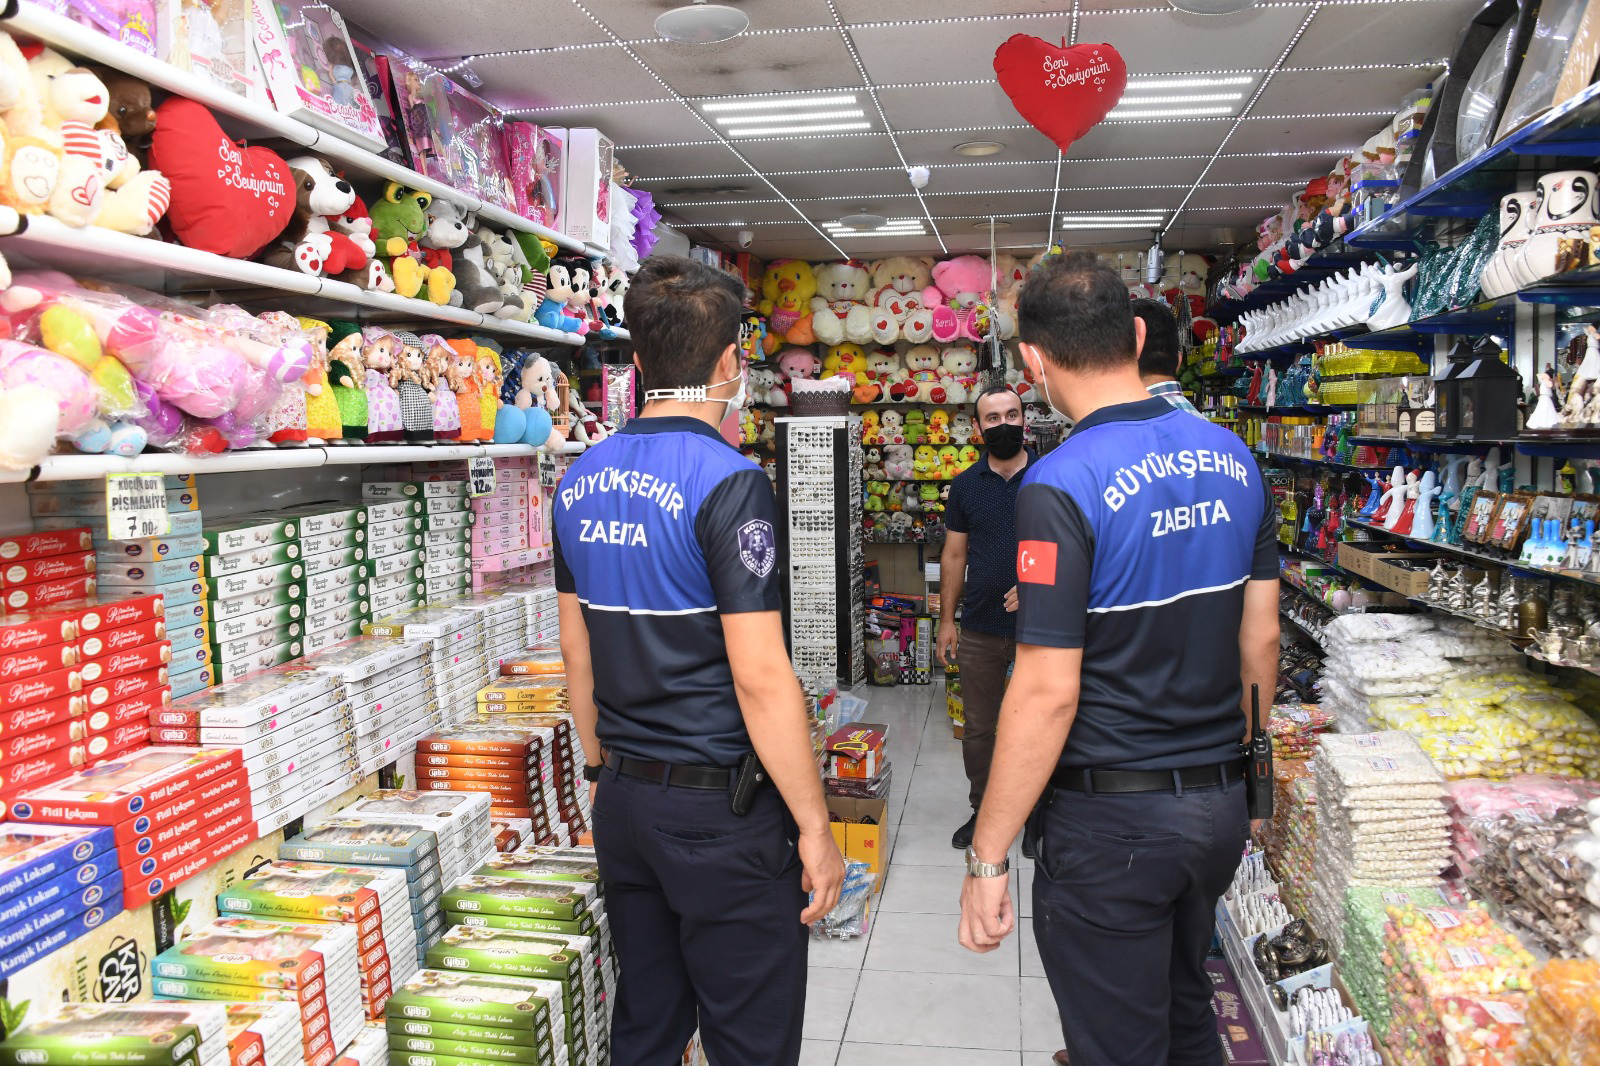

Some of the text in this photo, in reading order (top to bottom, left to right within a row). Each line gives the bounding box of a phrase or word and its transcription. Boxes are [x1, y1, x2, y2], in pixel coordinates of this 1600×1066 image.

[250, 0, 275, 45] Beau
[1043, 55, 1069, 72] Seni
[1057, 62, 1111, 86] Seviyorum
[219, 138, 242, 166] Seni
[232, 165, 285, 198] Seviyorum
[145, 480, 158, 490] BOY
[1103, 449, 1248, 512] BÜYÜKŞEHİR
[1271, 477, 1288, 486] 360
[561, 467, 684, 520] BÜYÜKŞEHİR
[1151, 499, 1231, 538] ZABITA
[743, 522, 769, 535] KONYA
[166, 780, 189, 796] Lokum
[64, 807, 98, 820] Lokum
[172, 799, 195, 816] Lokum
[174, 819, 197, 836] Lokum
[178, 838, 201, 855] Lokum
[23, 862, 55, 884] Lokum
[185, 857, 207, 875] Lokum
[27, 886, 60, 907] Lokum
[226, 899, 249, 909] yiba
[459, 901, 478, 910] yiba
[33, 908, 65, 930] Lokum
[0, 930, 67, 973] Karışık Lokum
[447, 958, 467, 967] yiba
[118, 942, 139, 1002] KAR
[407, 1007, 427, 1017] yiba
[408, 1024, 428, 1033] yiba
[411, 1040, 431, 1050] yiba
